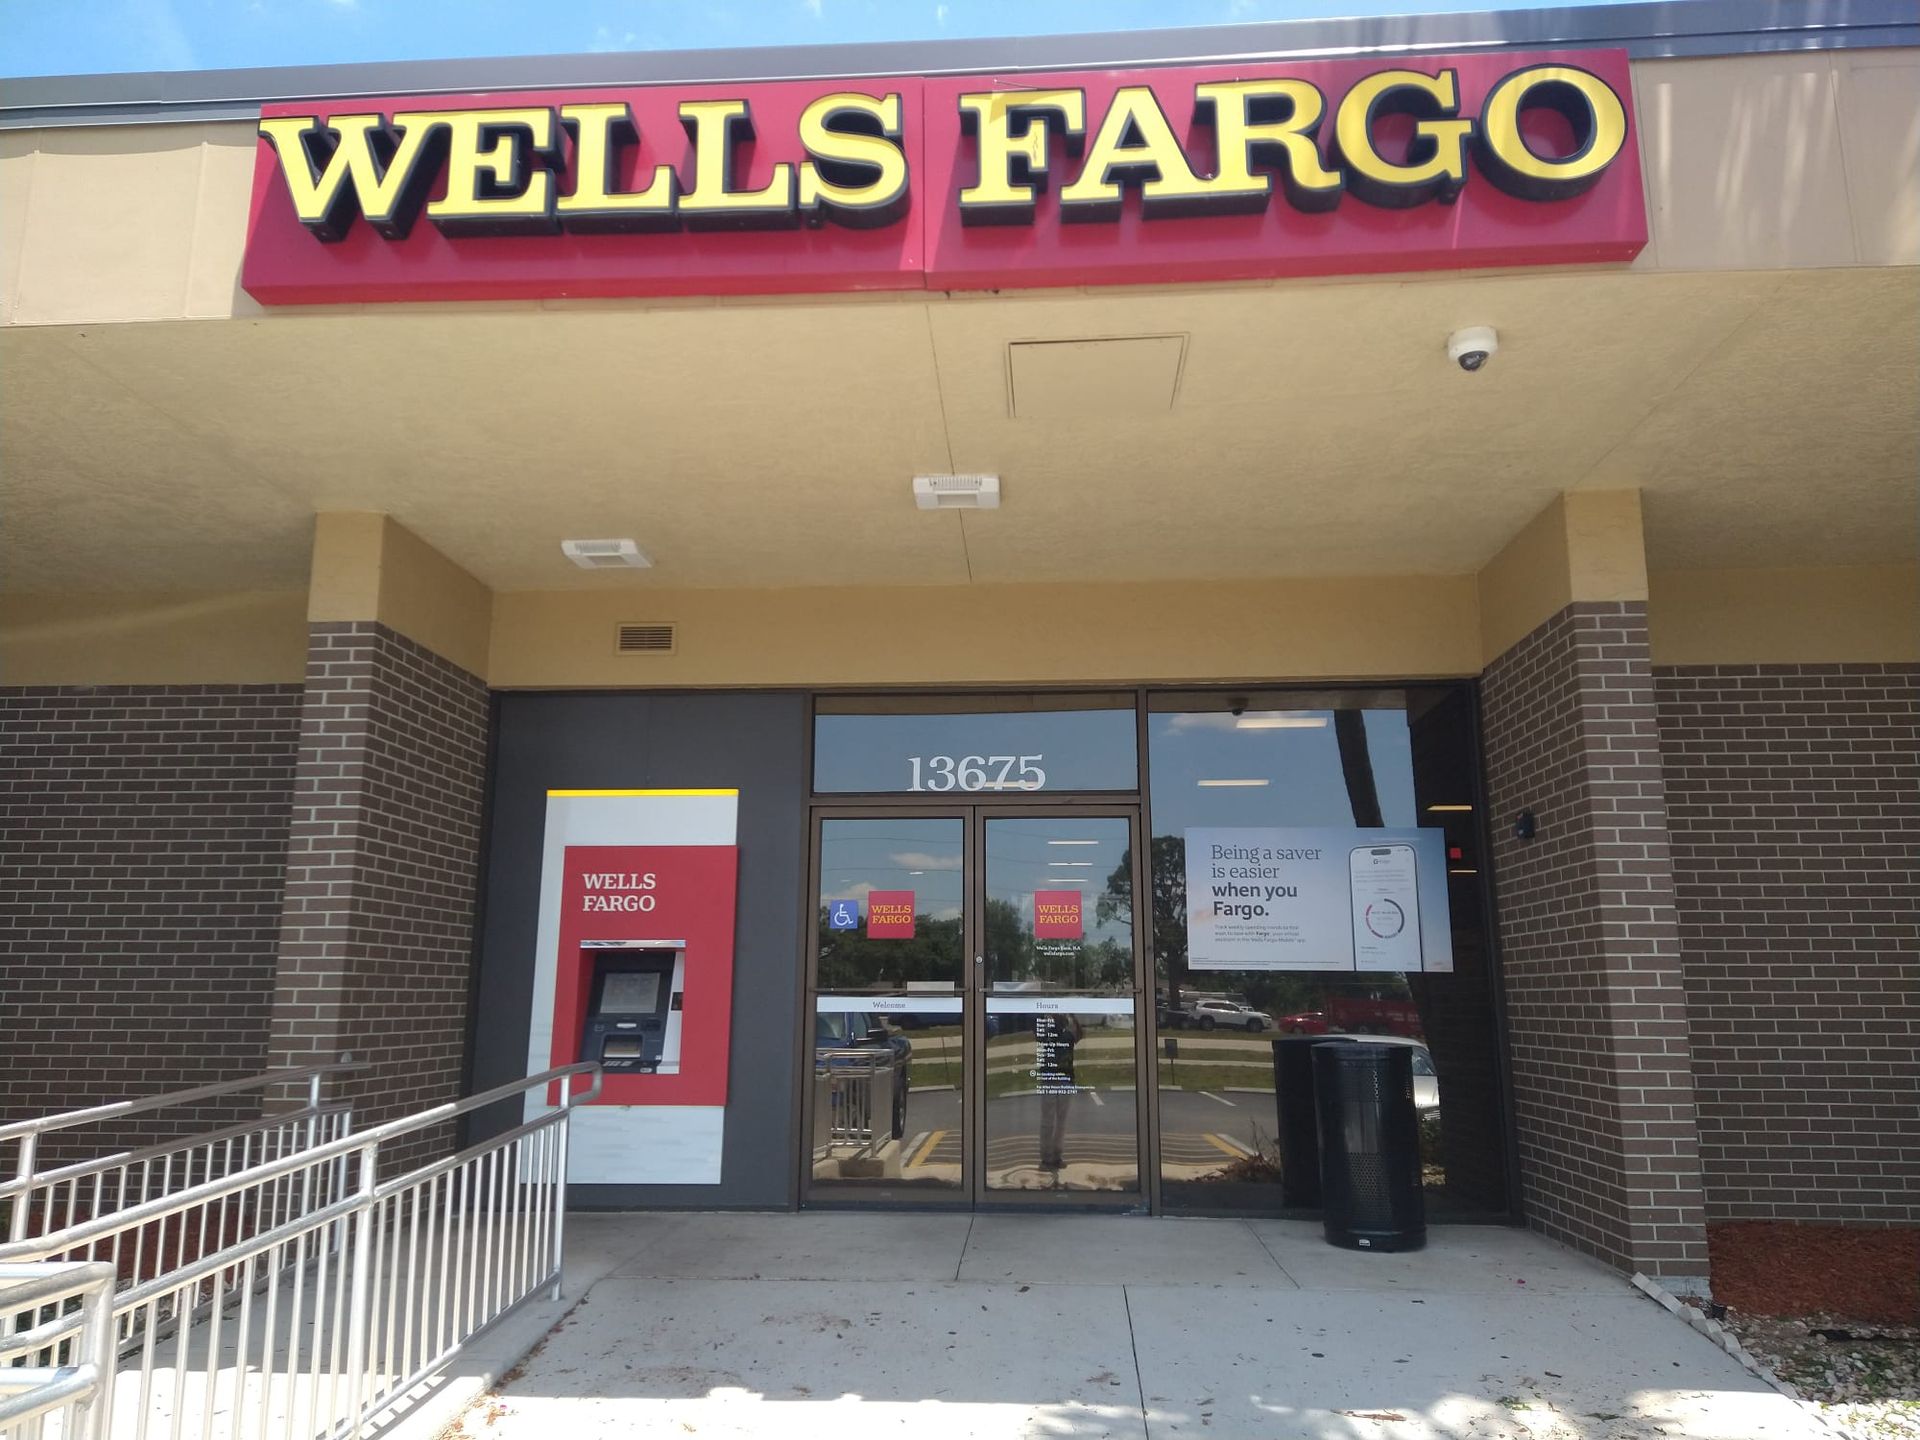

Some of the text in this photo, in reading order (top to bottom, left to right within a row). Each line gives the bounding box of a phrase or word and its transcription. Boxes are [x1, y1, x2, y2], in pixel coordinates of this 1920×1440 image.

[258, 66, 1627, 224] WELLS FARGO
[906, 754, 1046, 791] 13675
[1211, 844, 1322, 864] Being a saver
[1211, 863, 1280, 879] is easier
[582, 873, 656, 890] WELLS
[1212, 882, 1298, 902] when you
[582, 895, 656, 912] FARGO
[871, 905, 912, 914] WELLS
[1038, 904, 1079, 914] WELLS
[1213, 901, 1270, 920] Fargo.
[872, 915, 911, 924] FARGO
[1039, 915, 1079, 924] FARGO
[872, 1001, 906, 1010] Welcome
